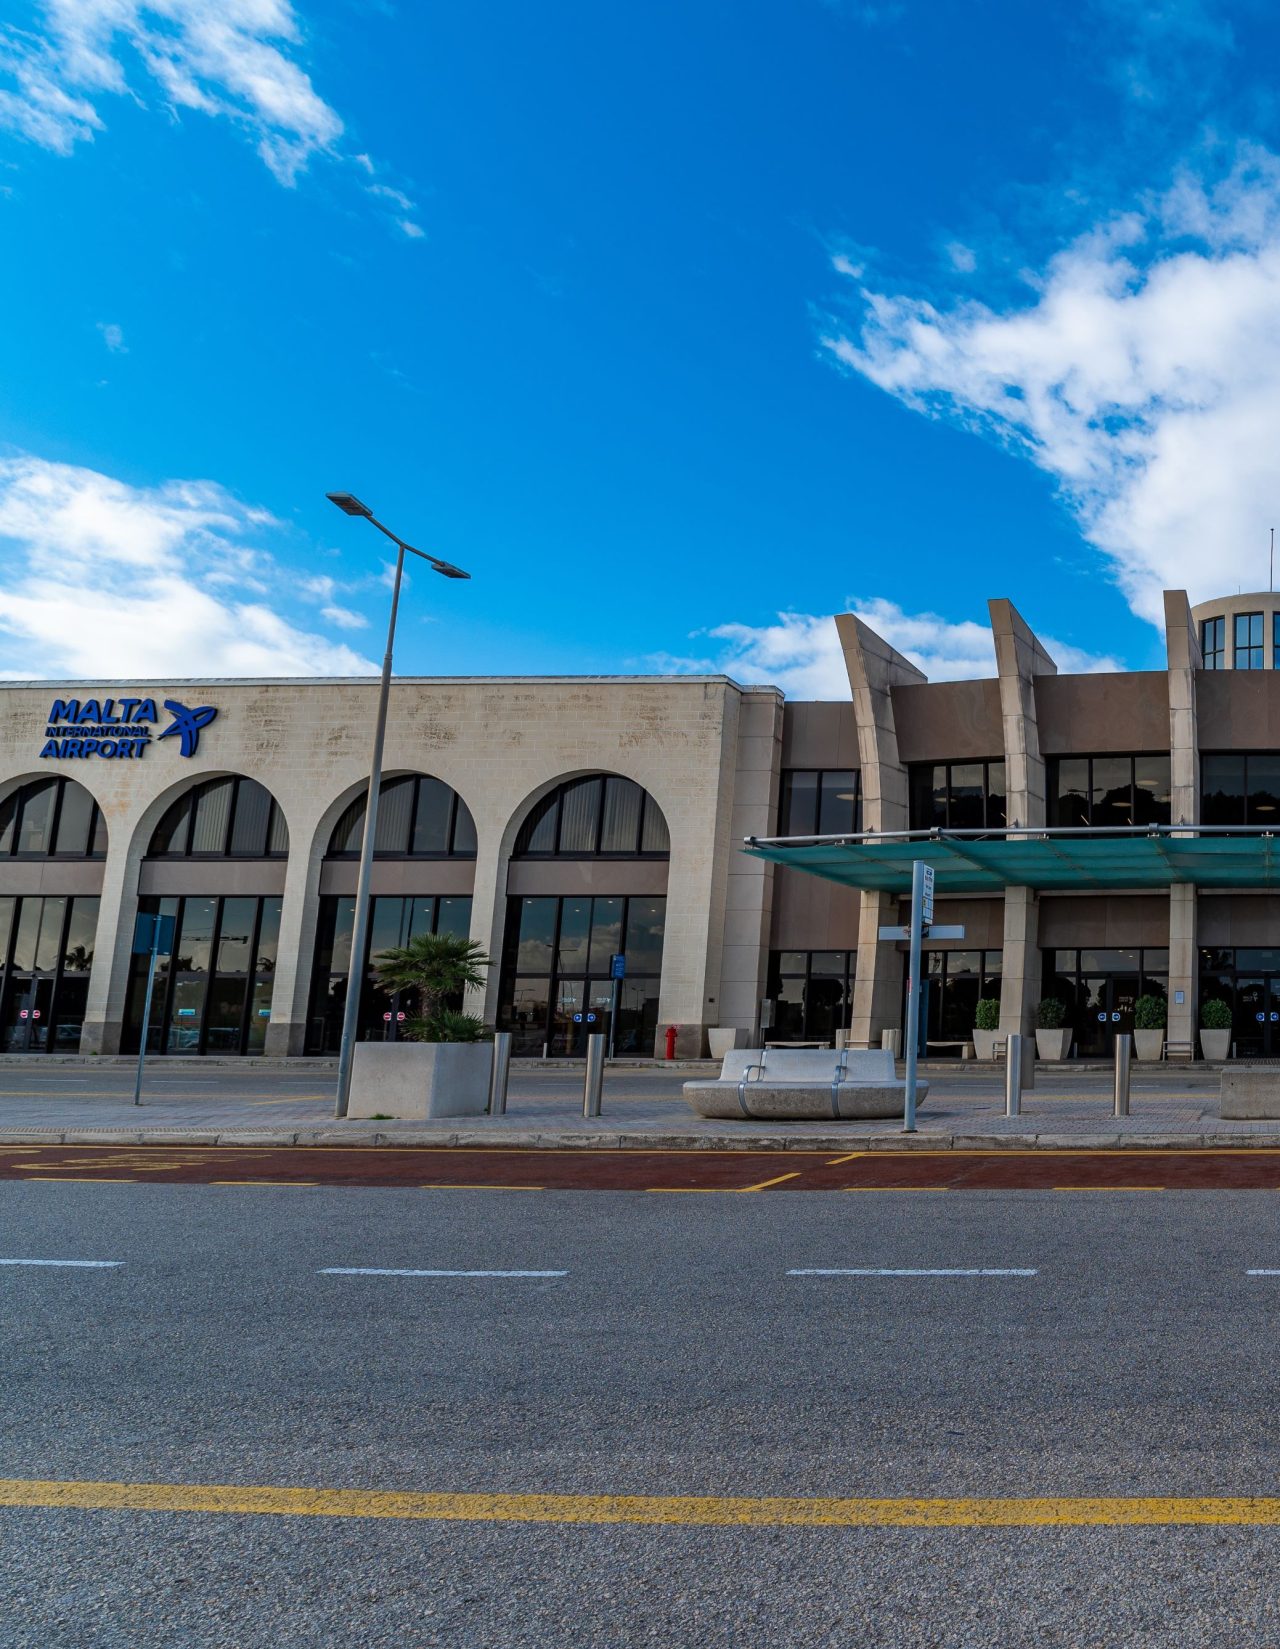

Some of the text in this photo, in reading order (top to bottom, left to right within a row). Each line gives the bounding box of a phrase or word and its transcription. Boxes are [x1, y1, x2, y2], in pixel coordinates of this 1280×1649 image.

[48, 698, 158, 723] MALTA
[44, 726, 152, 737] INTERNATIONAL
[39, 739, 151, 758] AIRPORT
